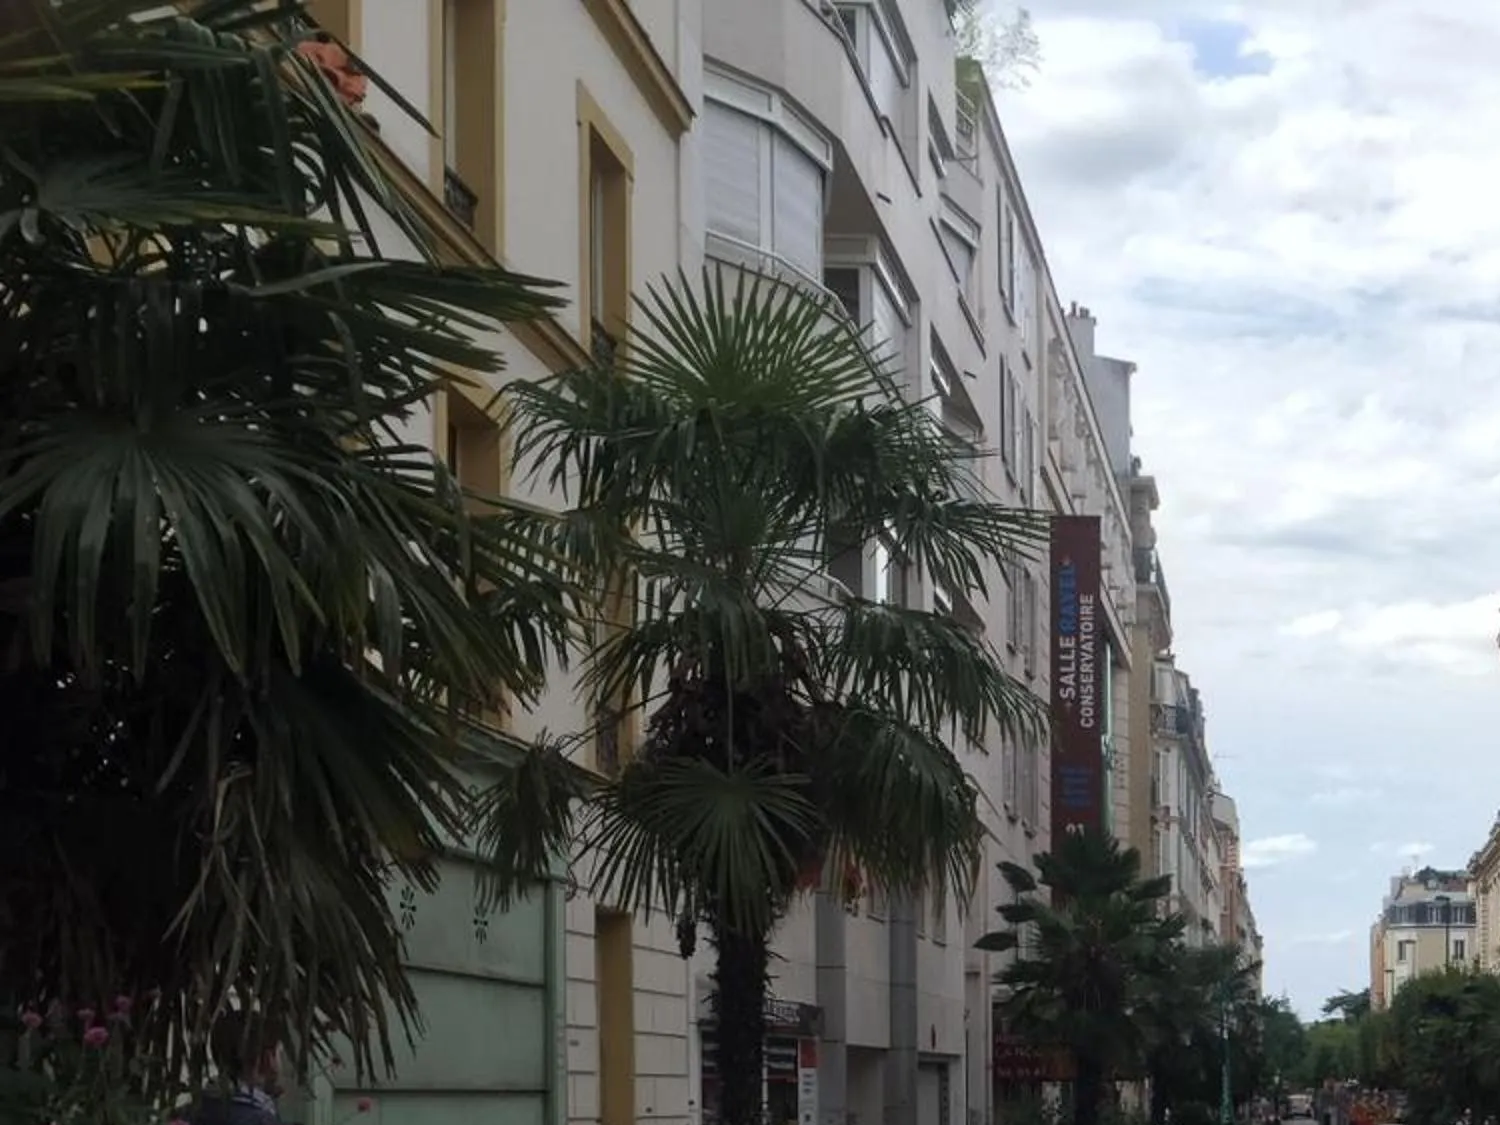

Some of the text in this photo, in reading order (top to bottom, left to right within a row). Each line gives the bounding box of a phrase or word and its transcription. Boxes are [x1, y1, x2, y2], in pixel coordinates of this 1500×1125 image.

[1059, 564, 1077, 700] SALLE RAVEL
[1080, 593, 1095, 728] CONSERVATOIRE
